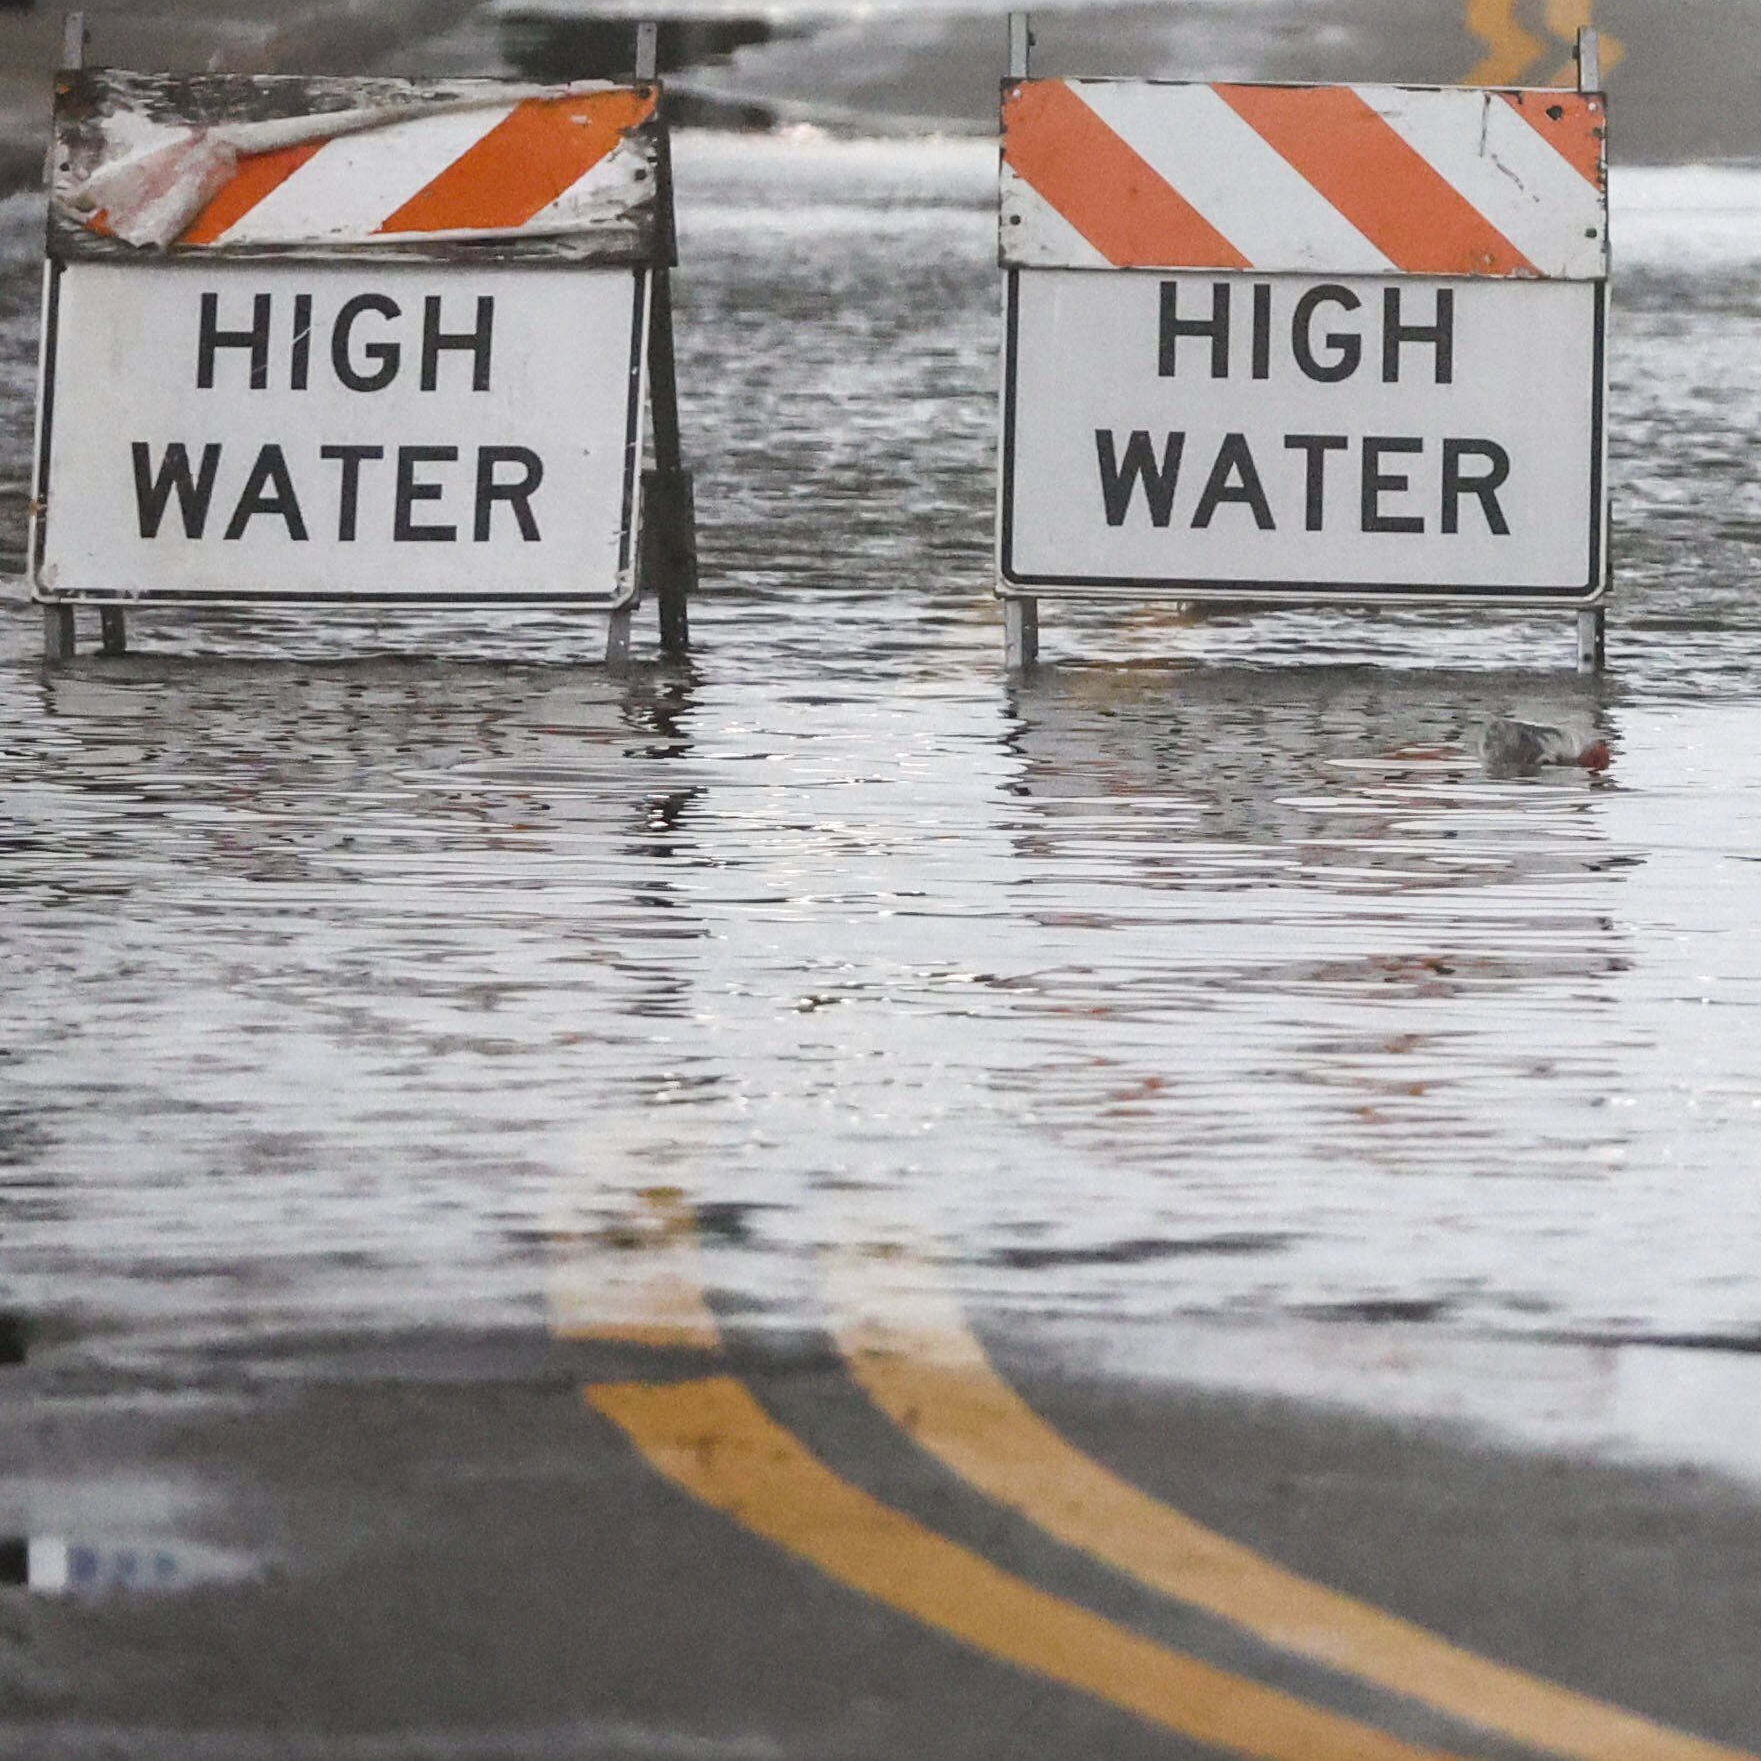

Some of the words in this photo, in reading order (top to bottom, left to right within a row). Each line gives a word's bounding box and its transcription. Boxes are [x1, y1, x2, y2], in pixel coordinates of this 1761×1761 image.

[196, 292, 494, 393] HIGH
[1158, 280, 1454, 385] HIGH
[131, 441, 545, 543] WATER
[1095, 429, 1511, 536] WATER
